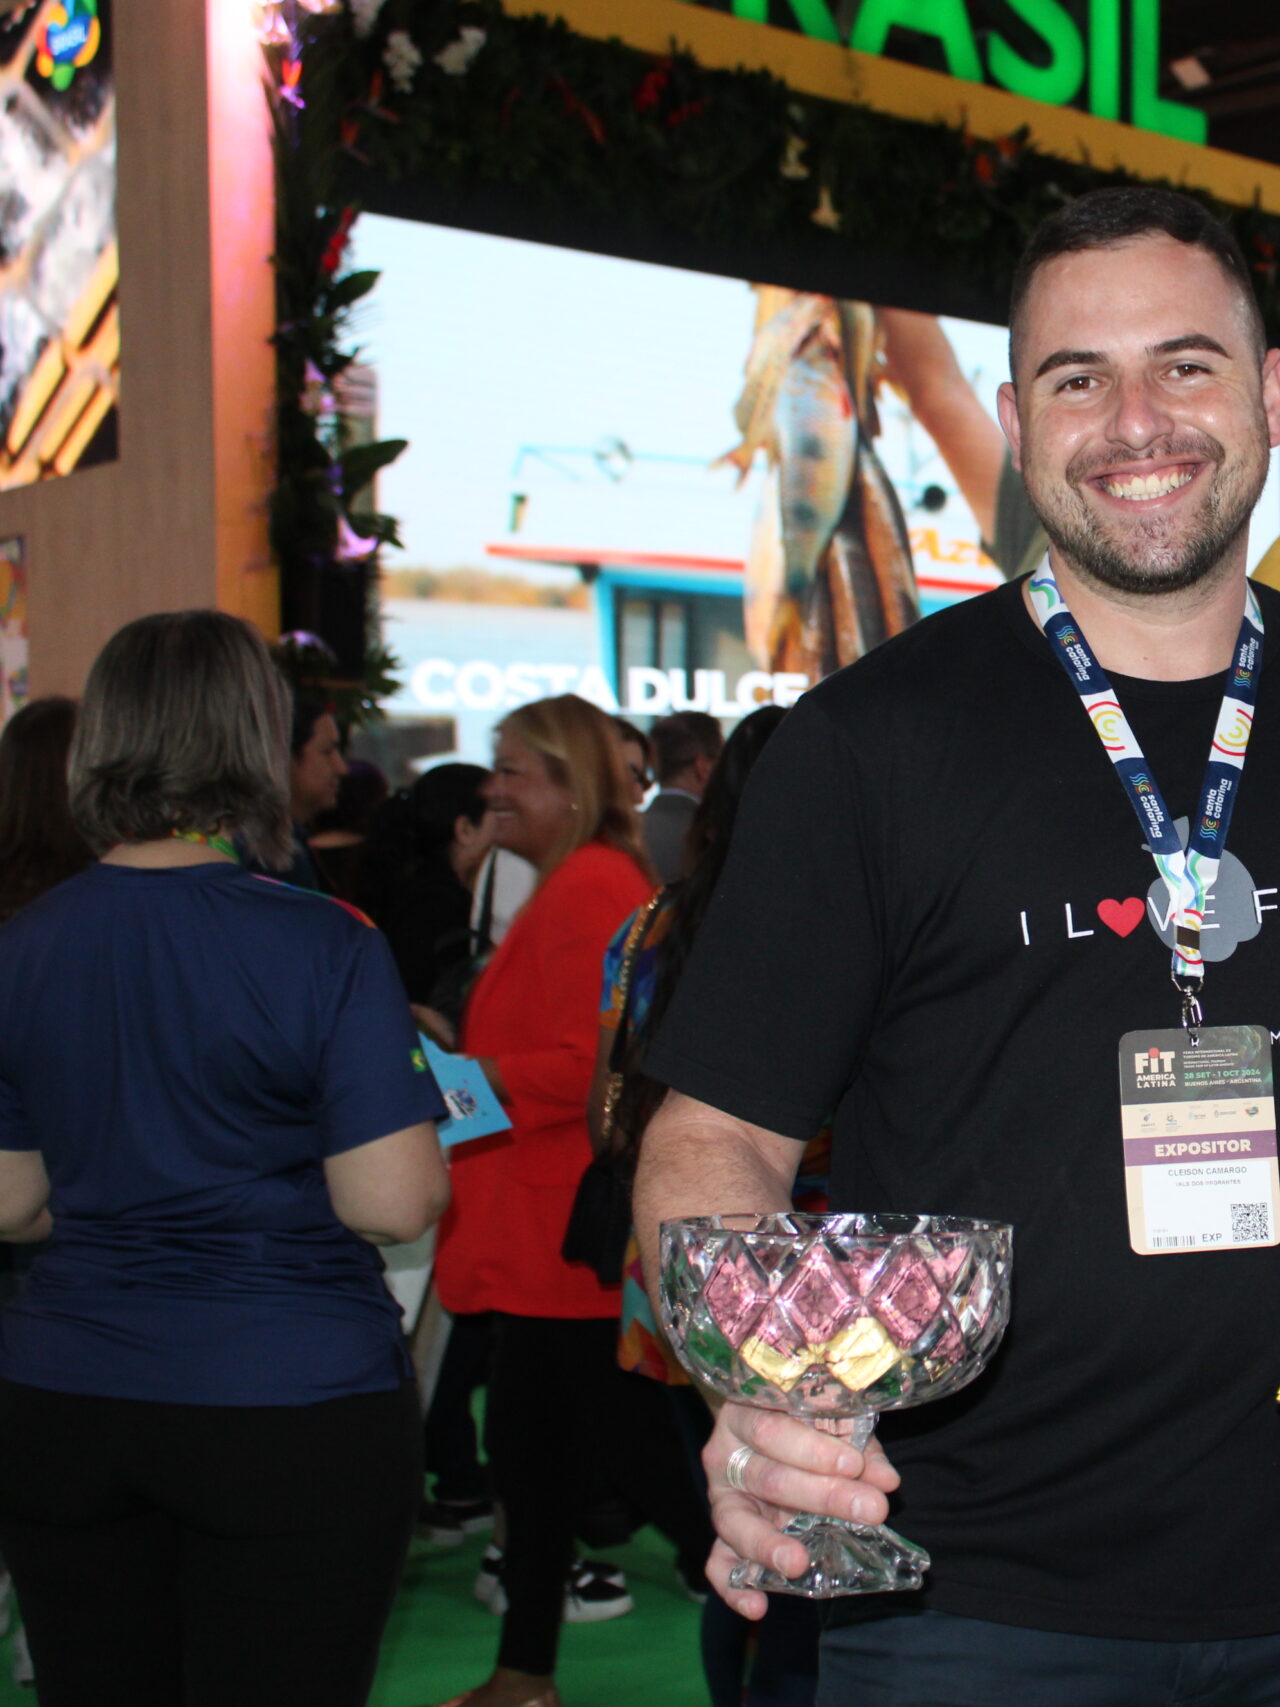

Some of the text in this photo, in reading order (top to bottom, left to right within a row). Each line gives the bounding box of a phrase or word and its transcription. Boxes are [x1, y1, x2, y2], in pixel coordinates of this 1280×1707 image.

[1066, 646, 1091, 681] catarina
[1074, 644, 1092, 667] santa
[1238, 643, 1249, 668] santa
[410, 659, 810, 717] COSTA DULCE
[1148, 794, 1164, 822] santa
[1205, 788, 1217, 816] santa
[1214, 778, 1228, 819] catarina
[1140, 796, 1163, 838] catarina
[1020, 911, 1030, 946] I
[1136, 1073, 1176, 1082] AMERICA
[1137, 1080, 1176, 1088] LATINA
[1154, 1139, 1251, 1158] EXPOSITOR
[1168, 1166, 1248, 1176] CLEISON CAMARGO
[1202, 1233, 1222, 1242] EXP
